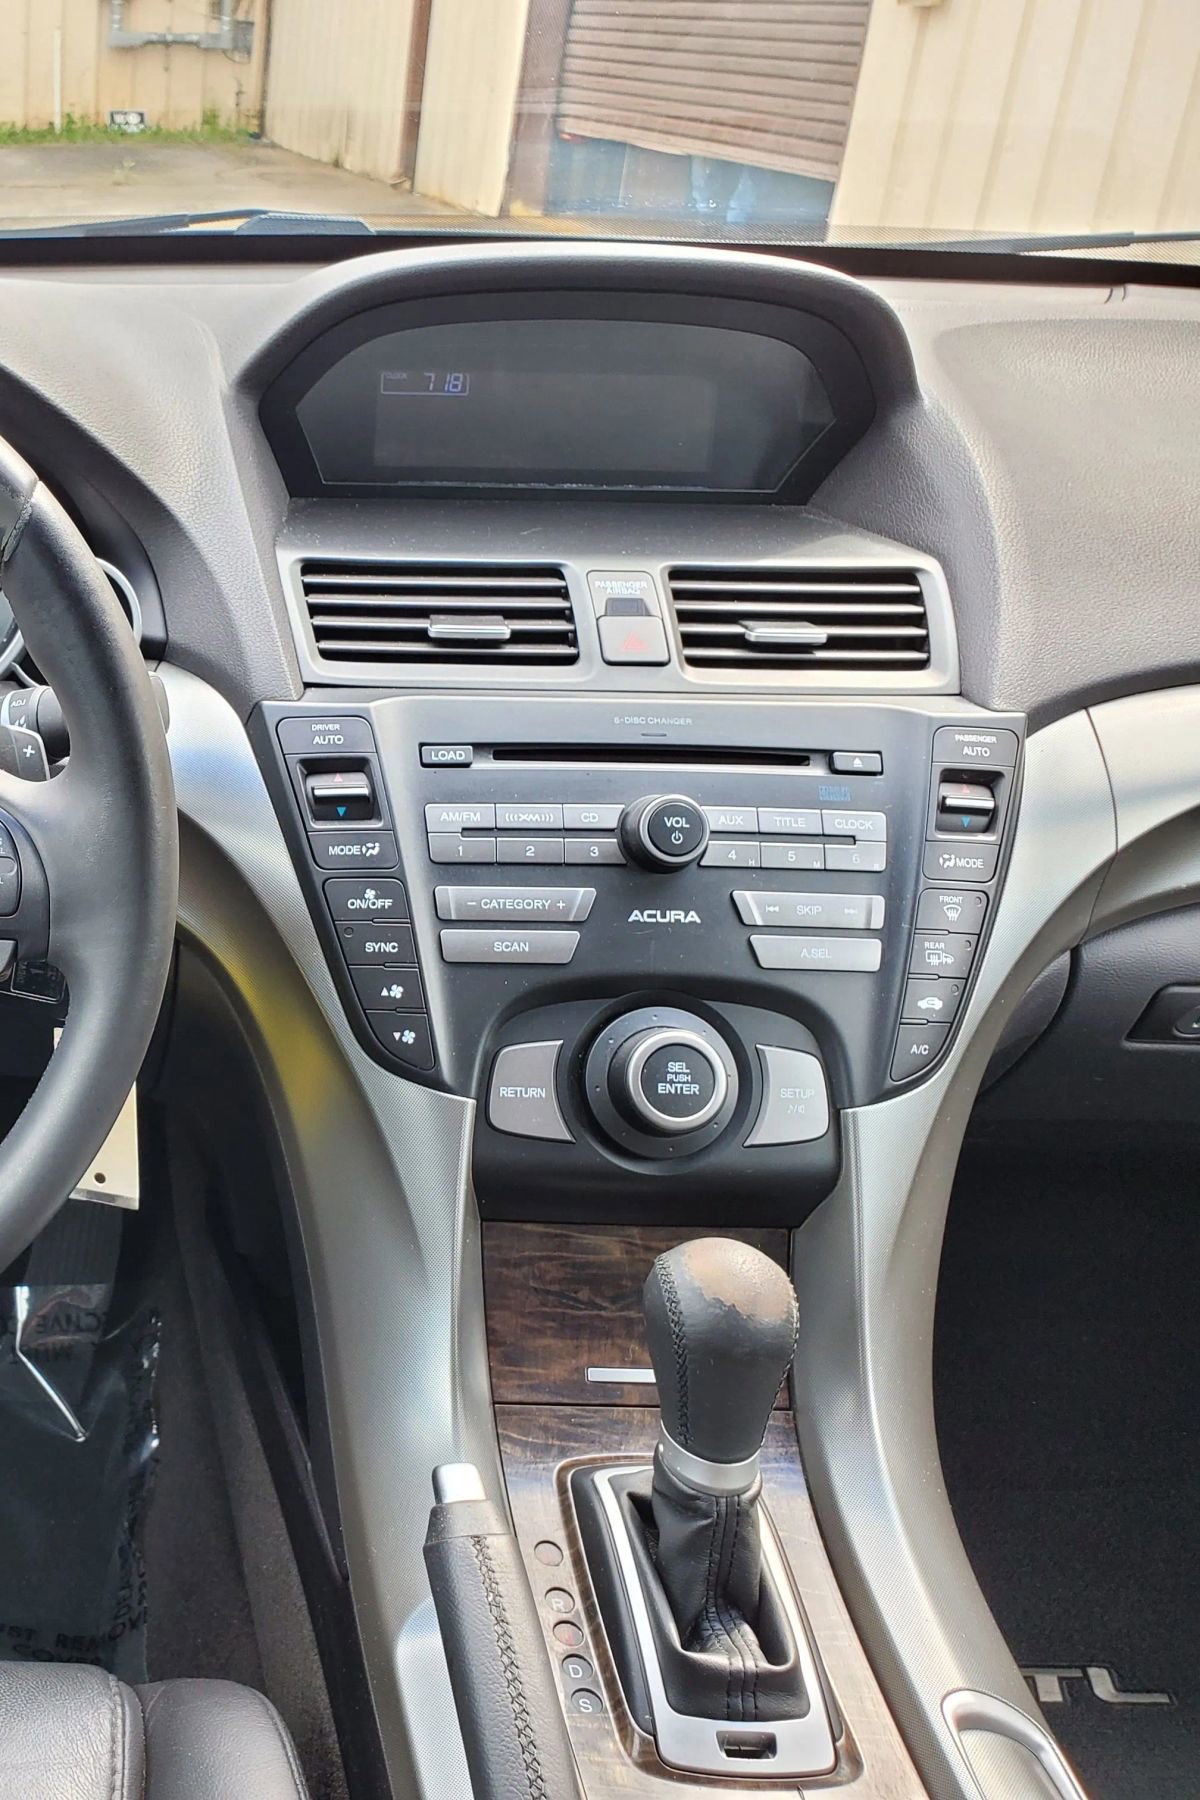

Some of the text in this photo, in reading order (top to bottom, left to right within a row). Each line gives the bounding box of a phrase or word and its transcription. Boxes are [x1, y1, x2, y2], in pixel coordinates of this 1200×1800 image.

[311, 723, 341, 731] DRIVER
[647, 717, 693, 726] CHANGER
[312, 734, 345, 746] AUTO
[954, 734, 998, 744] PASSENGER
[431, 750, 466, 761] LOAD
[962, 746, 991, 757] AUTO
[440, 811, 482, 822] AM/FM
[581, 812, 599, 823] CD
[718, 815, 744, 826] AUX
[663, 816, 691, 829] VOL
[772, 817, 807, 828] TITLE
[834, 818, 874, 830] CLOCK
[328, 845, 362, 856] MODE
[457, 846, 464, 857] 1
[525, 846, 536, 857] 2
[590, 846, 600, 858] 3
[727, 849, 737, 861] 4
[787, 851, 796, 862] 5
[852, 853, 861, 864] 6
[956, 857, 985, 869] MODE
[347, 899, 394, 911] ON/OFF
[480, 899, 552, 910] CATEGORY
[939, 895, 963, 904] FRONT
[796, 905, 823, 916] SKIP
[627, 909, 702, 924] ACURA
[365, 941, 400, 953] SYNC
[493, 941, 530, 953] SCAN
[924, 941, 946, 950] REAR
[910, 1044, 930, 1055] A/C
[667, 1061, 691, 1073] SEL
[666, 1073, 692, 1083] PUSH
[499, 1087, 546, 1099] RETURN
[657, 1083, 700, 1096] ENTER
[568, 1665, 583, 1679] D
[1020, 1665, 1172, 1704] TL
[578, 1699, 593, 1713] S
